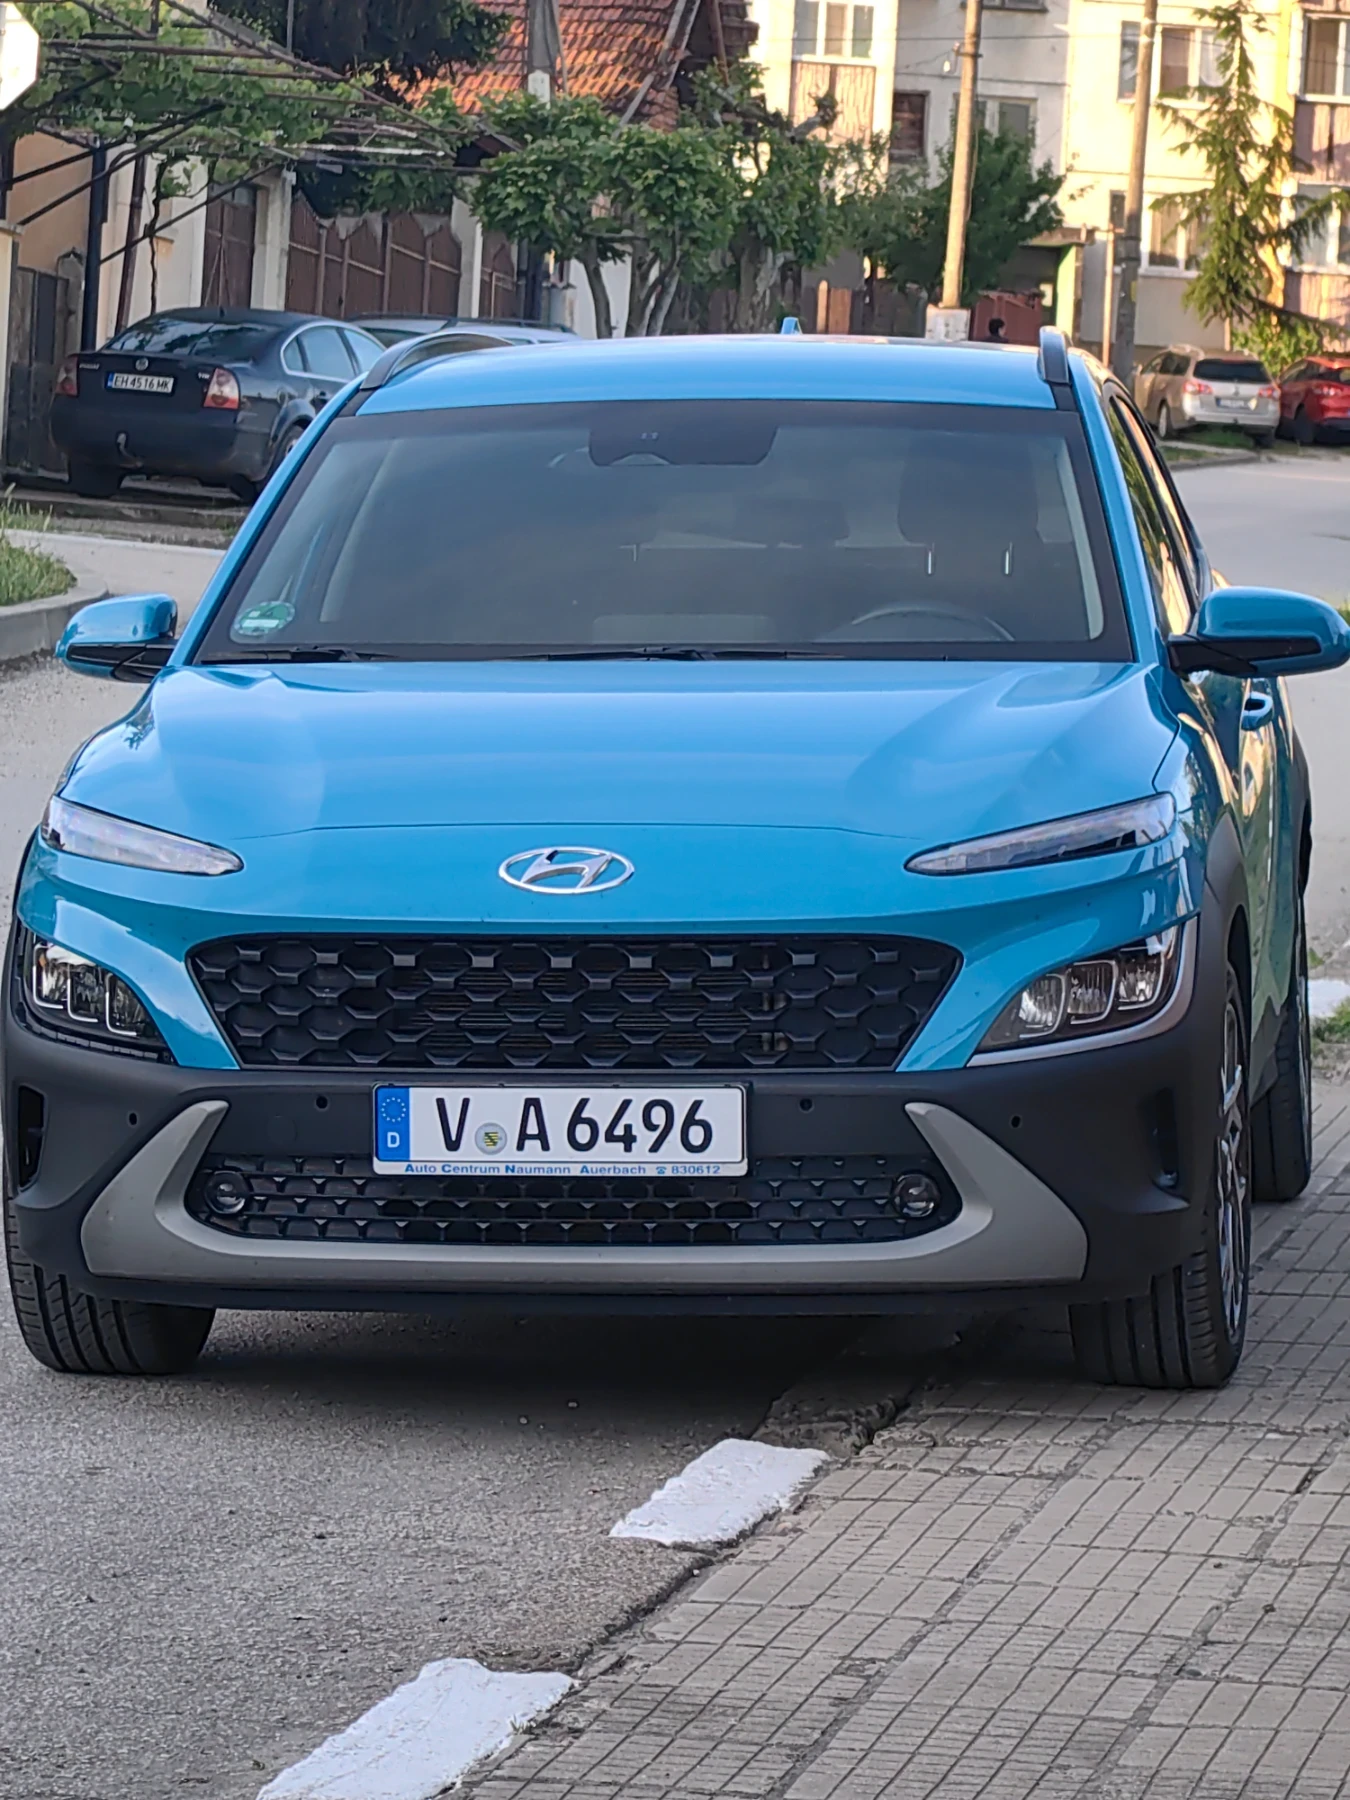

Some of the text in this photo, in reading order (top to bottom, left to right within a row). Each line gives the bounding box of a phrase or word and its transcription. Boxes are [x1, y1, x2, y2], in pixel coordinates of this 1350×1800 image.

[435, 1097, 713, 1154] V A 6496
[387, 1132, 400, 1148] D
[405, 1163, 721, 1175] Auto Centrum Naumann Auerbach 830612
